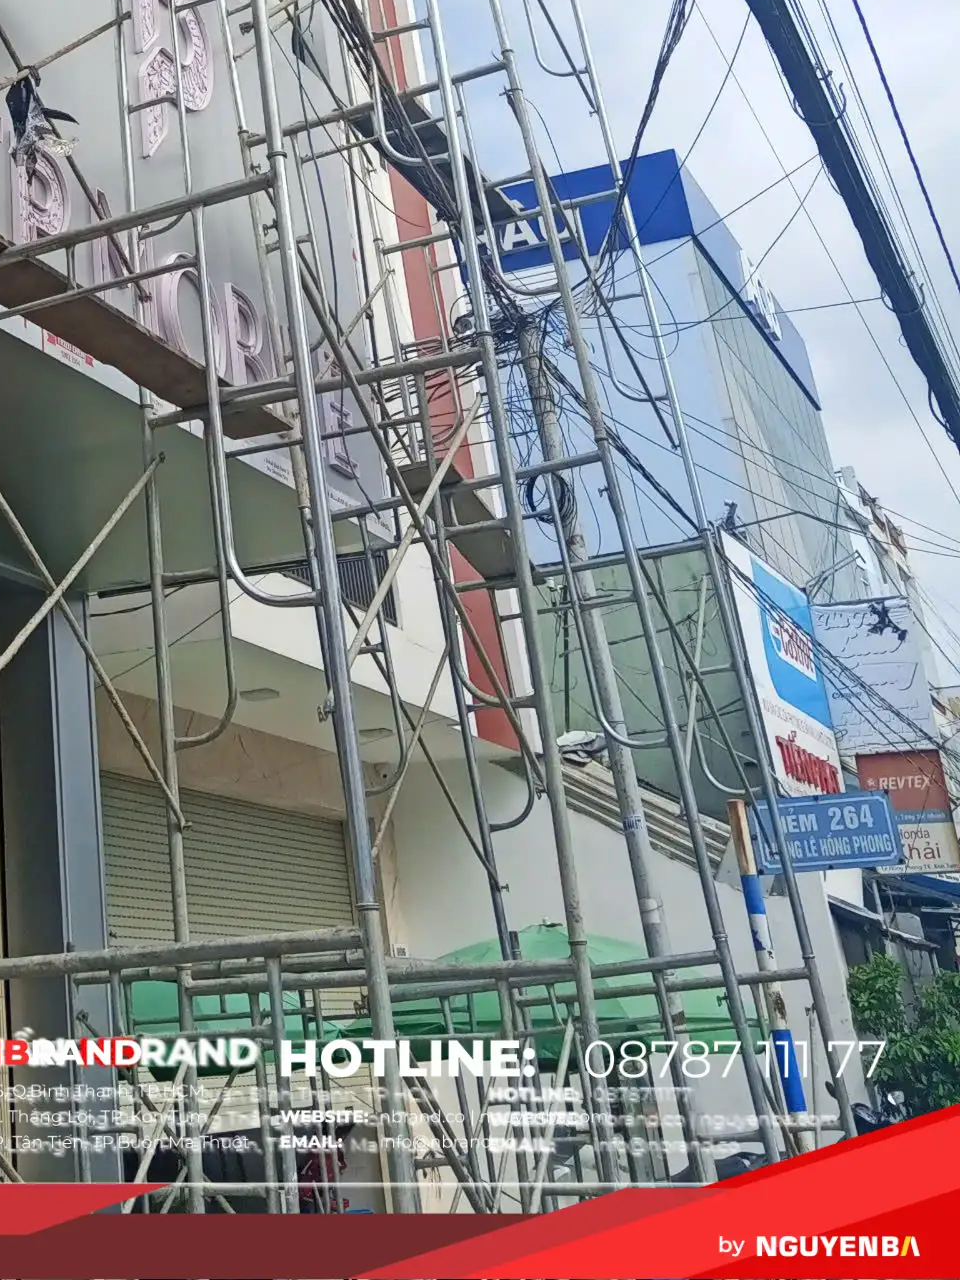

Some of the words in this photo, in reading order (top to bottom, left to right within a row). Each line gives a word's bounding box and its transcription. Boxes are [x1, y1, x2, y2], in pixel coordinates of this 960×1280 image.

[879, 775, 932, 790] REVTEX
[827, 803, 874, 832] 264
[803, 835, 819, 858] LÊ
[852, 833, 893, 855] PHONG
[906, 841, 941, 860] hải
